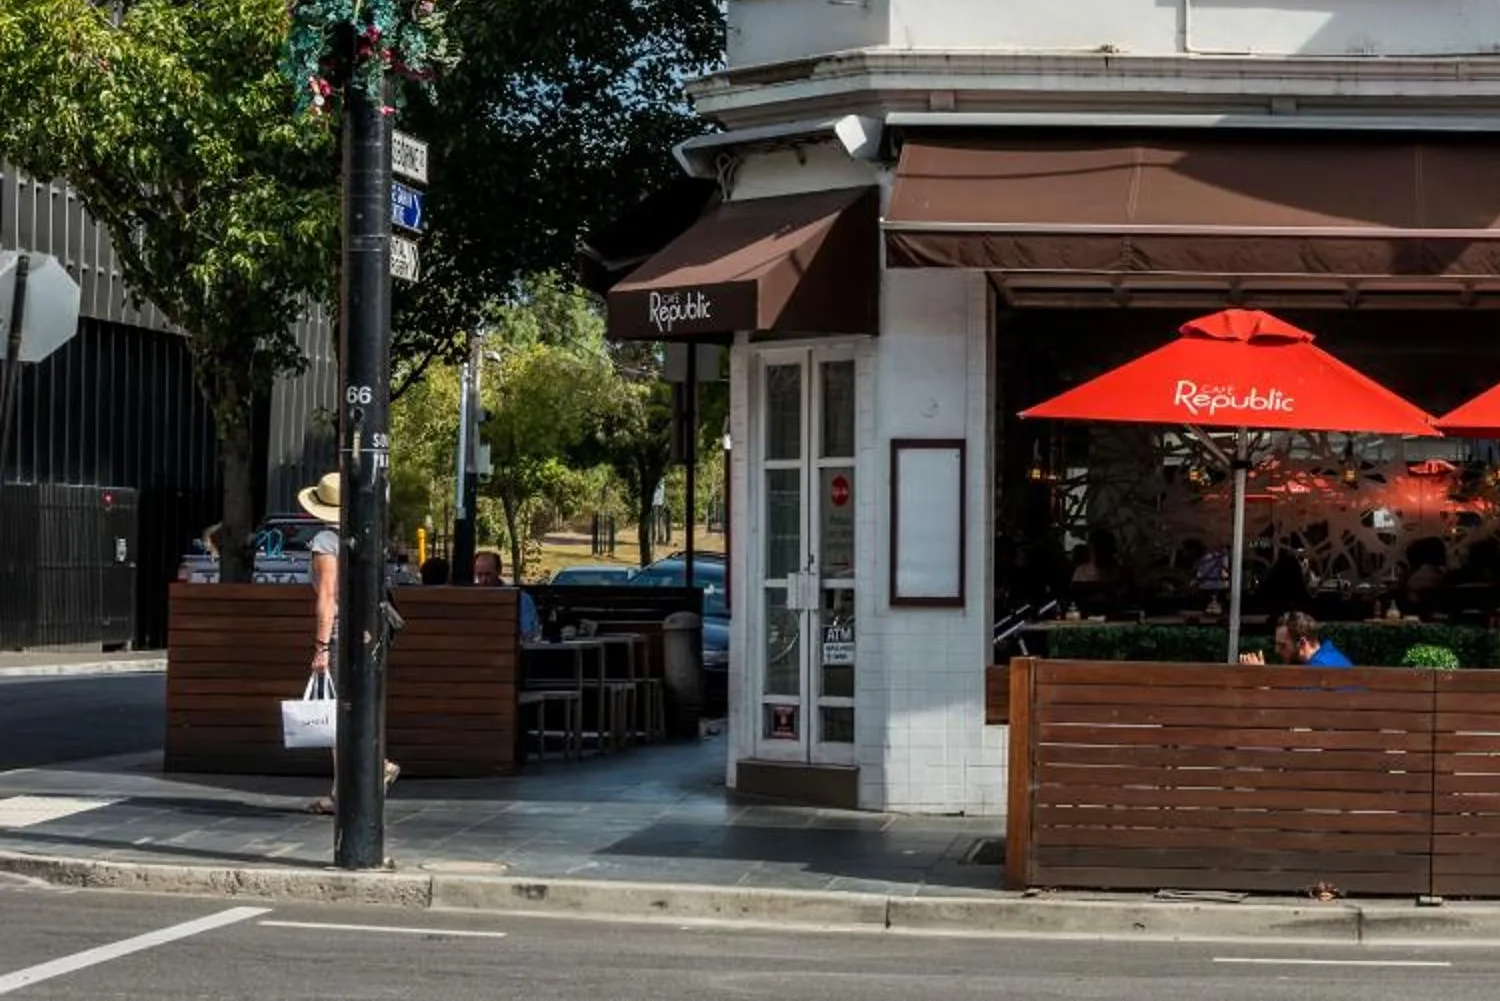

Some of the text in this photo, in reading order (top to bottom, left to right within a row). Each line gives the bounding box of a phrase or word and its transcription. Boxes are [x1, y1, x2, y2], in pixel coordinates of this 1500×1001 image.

[649, 291, 711, 333] Republic
[346, 386, 372, 404] 66
[1174, 379, 1295, 416] Republic
[202, 574, 298, 583] TOTA
